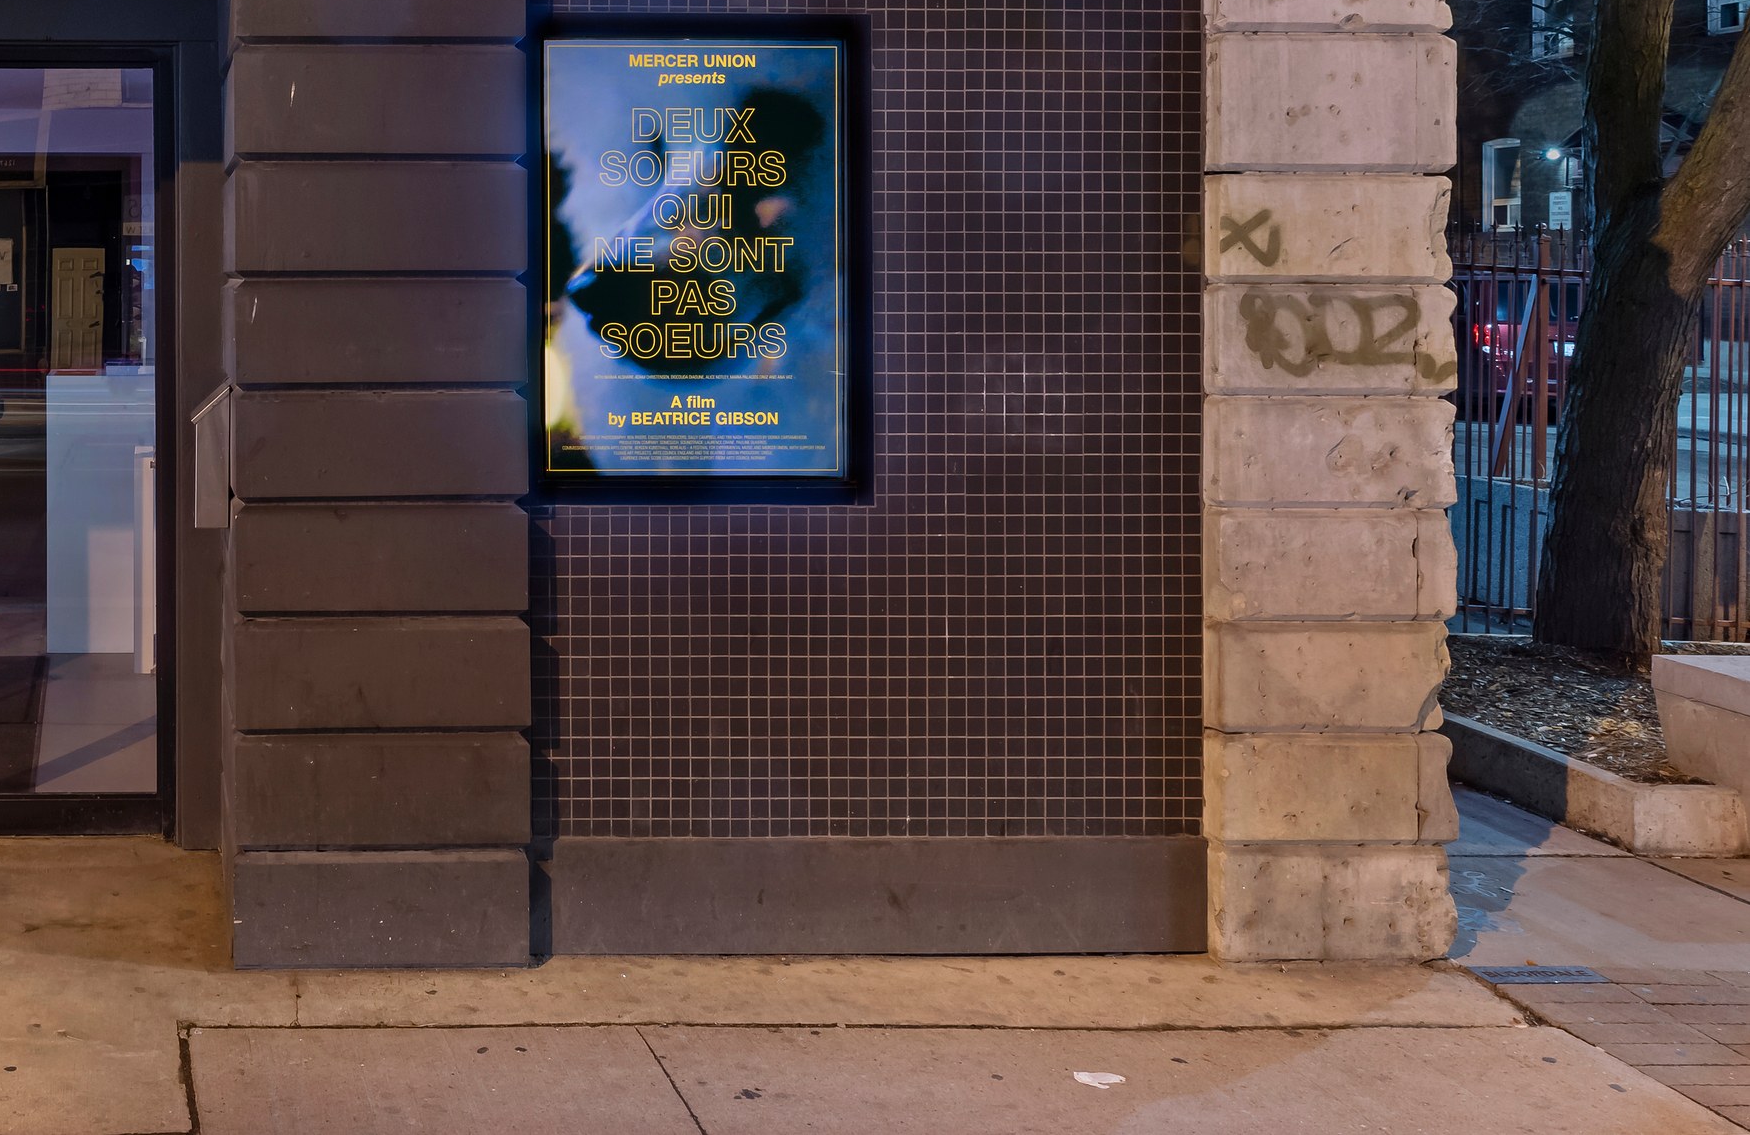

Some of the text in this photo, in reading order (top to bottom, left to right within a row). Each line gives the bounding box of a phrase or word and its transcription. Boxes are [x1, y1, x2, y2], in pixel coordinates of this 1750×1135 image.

[629, 54, 757, 68] MERCER UNION
[658, 71, 726, 87] presents
[631, 107, 757, 144] DEUX
[598, 150, 788, 188] SOEURS
[652, 193, 733, 232] QUI
[594, 237, 794, 274] NE SONT
[651, 279, 737, 316] PAS
[599, 322, 788, 360] SOEURS
[608, 411, 779, 427] by BEATRICE GIBSON
[670, 396, 716, 409] A film
